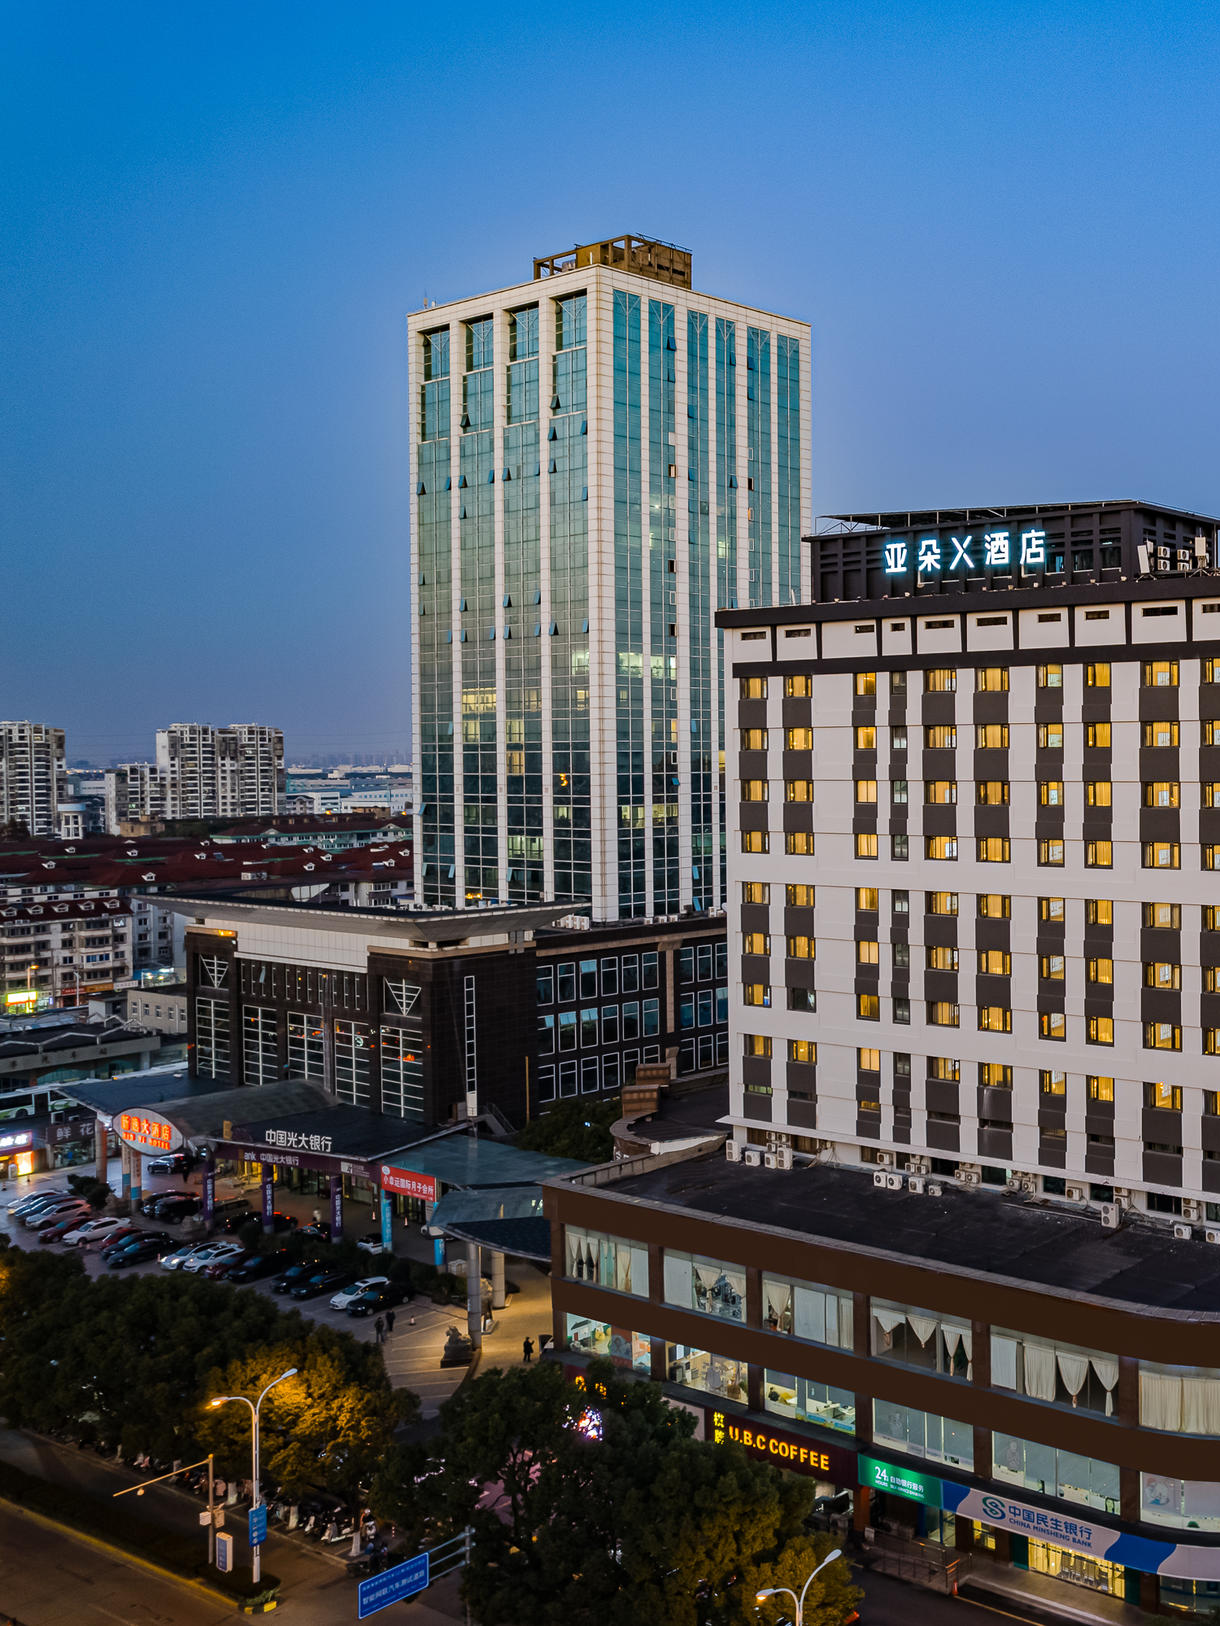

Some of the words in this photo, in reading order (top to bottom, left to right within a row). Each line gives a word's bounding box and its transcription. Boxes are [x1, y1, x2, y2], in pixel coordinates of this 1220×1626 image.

[885, 530, 1046, 574] 亚朵X酒店
[265, 1129, 332, 1152] 中国光大银行
[728, 1425, 766, 1451] U.B.C
[769, 1438, 830, 1471] COFFEE
[1008, 1505, 1092, 1541] 中国民生银行
[1009, 1518, 1031, 1530] CHINA
[1033, 1525, 1070, 1542] MINSHENG
[1072, 1537, 1092, 1548] BANK
